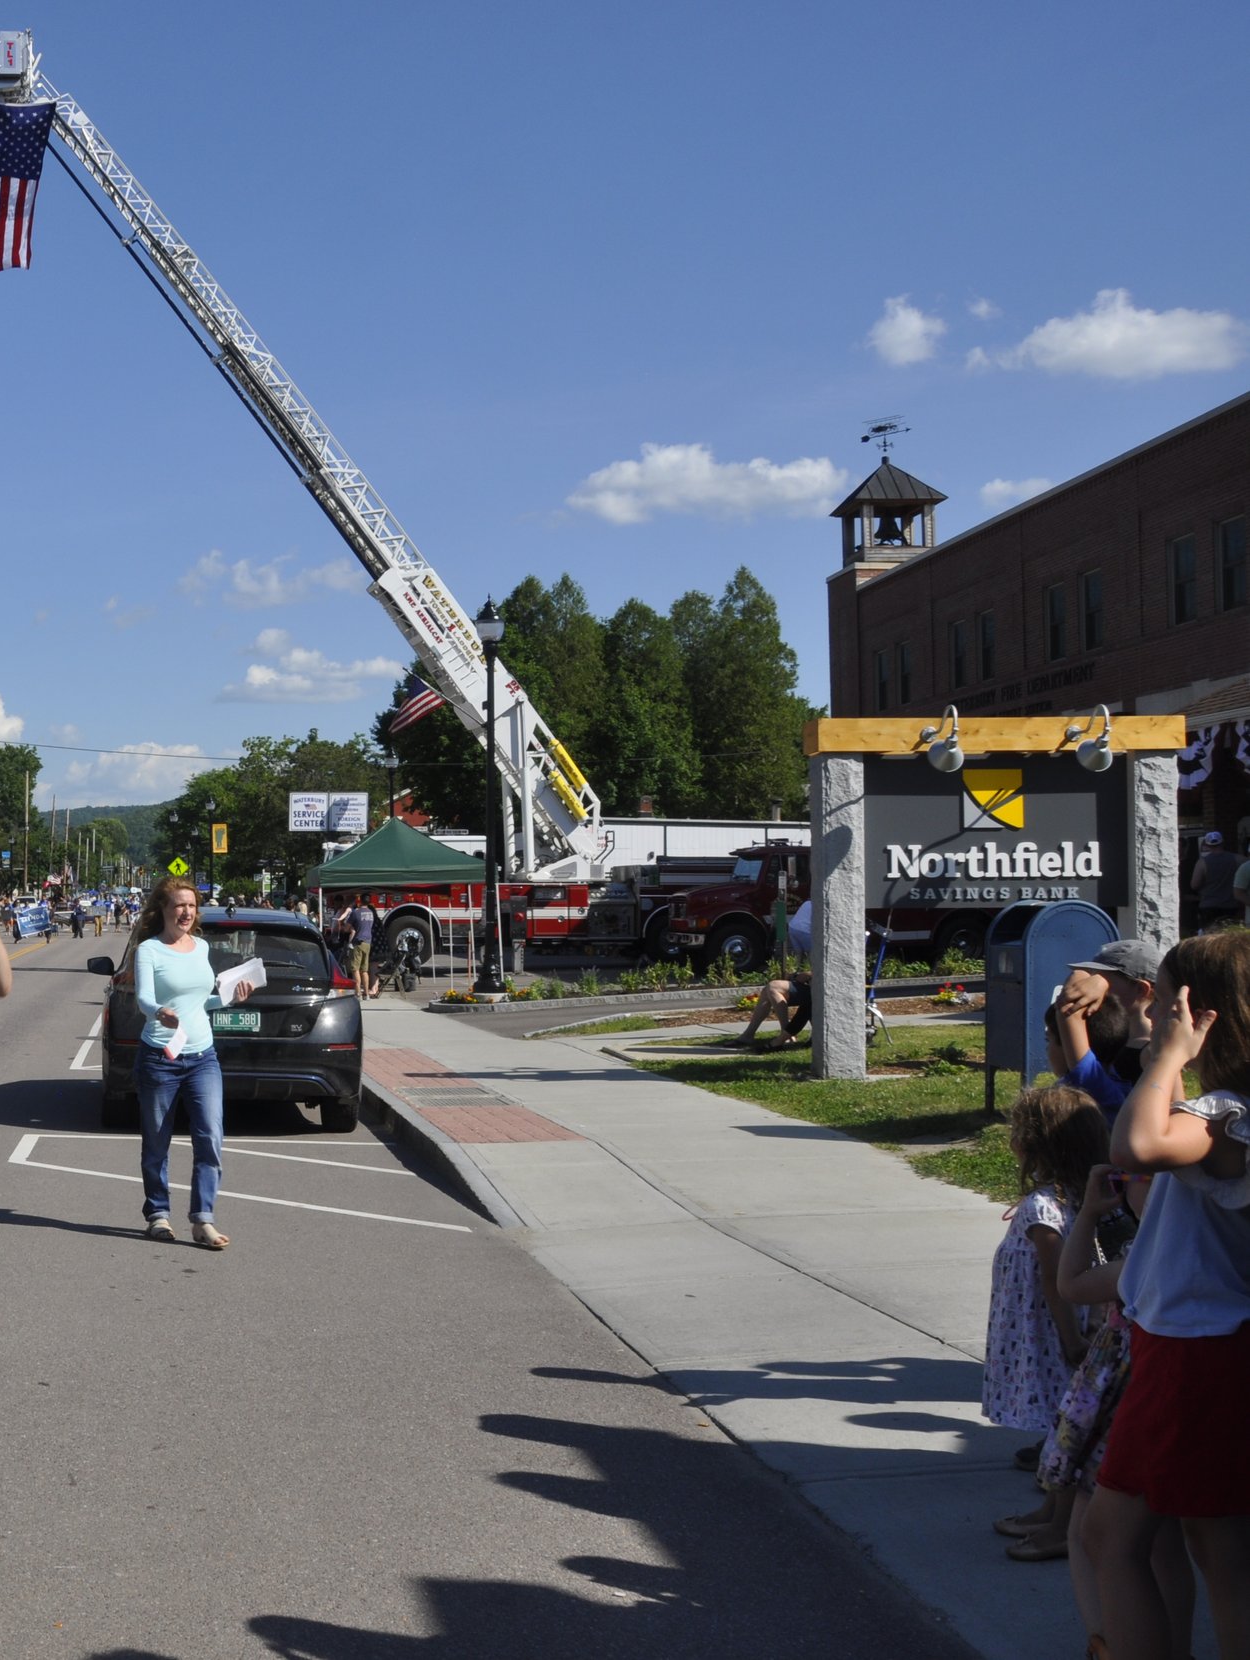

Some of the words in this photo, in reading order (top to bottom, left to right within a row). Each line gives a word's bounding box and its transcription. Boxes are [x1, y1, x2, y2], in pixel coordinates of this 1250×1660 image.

[422, 574, 497, 674] WATERBUR
[293, 810, 326, 819] SERVICE
[293, 819, 326, 828] CENTER
[886, 841, 1102, 879] Northfield
[910, 887, 1011, 900] SAVINGS
[1021, 886, 1081, 900] BANK
[216, 1012, 234, 1025] HNF
